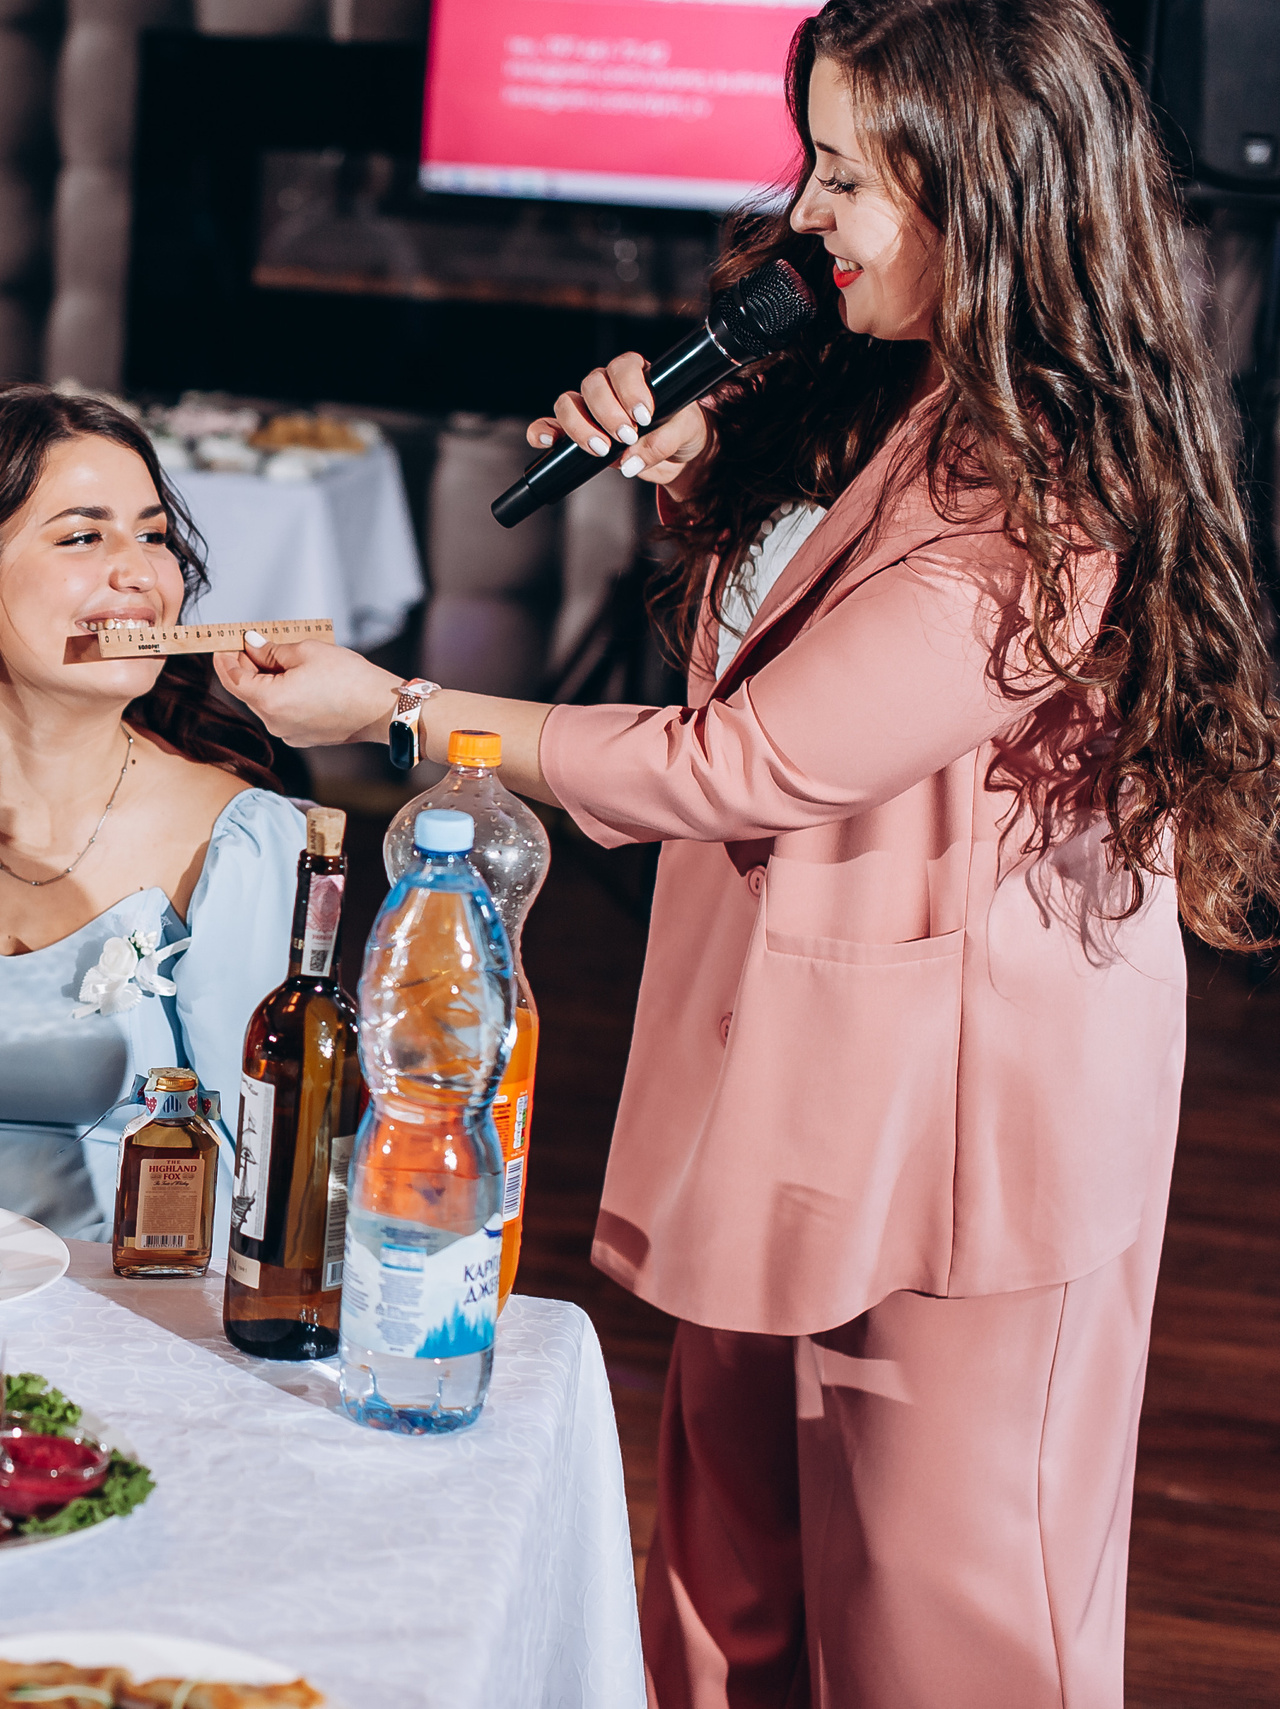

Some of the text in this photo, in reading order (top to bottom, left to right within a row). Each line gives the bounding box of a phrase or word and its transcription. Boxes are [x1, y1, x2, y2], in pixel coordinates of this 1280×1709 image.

[105, 635, 109, 643] 0
[128, 634, 132, 642] 2
[162, 632, 166, 640] 5
[173, 632, 178, 640] 6
[185, 631, 189, 639] 7
[207, 630, 212, 638] 9
